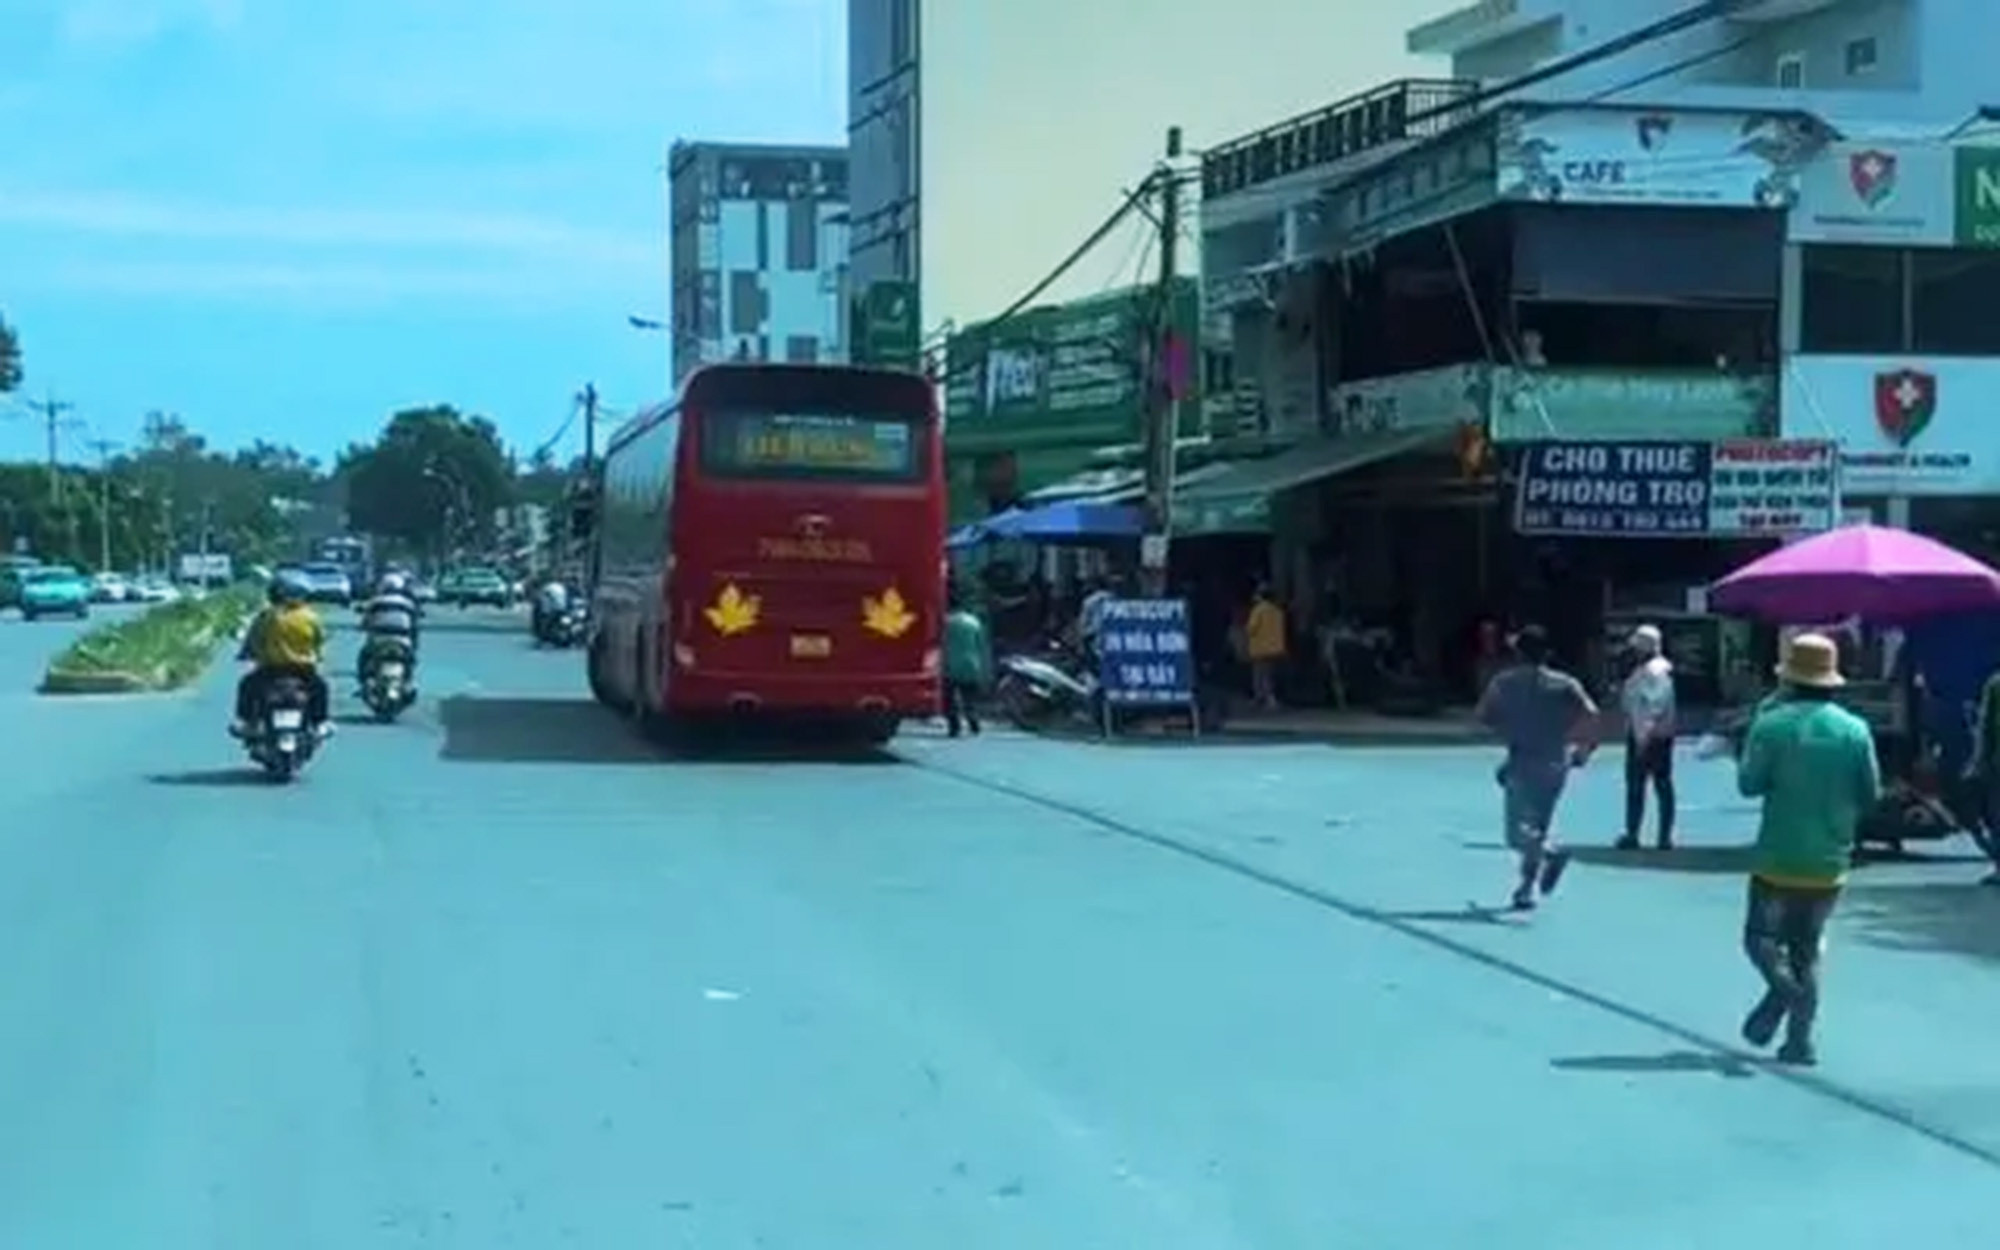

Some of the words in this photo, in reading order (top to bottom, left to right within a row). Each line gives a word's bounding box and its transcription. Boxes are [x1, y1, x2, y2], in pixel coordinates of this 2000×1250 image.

[1543, 447, 1608, 472] CHO
[1527, 475, 1638, 504] PHÒNG
[1649, 478, 1706, 507] TRỌ
[1103, 600, 1185, 619] PHOTOCOPY
